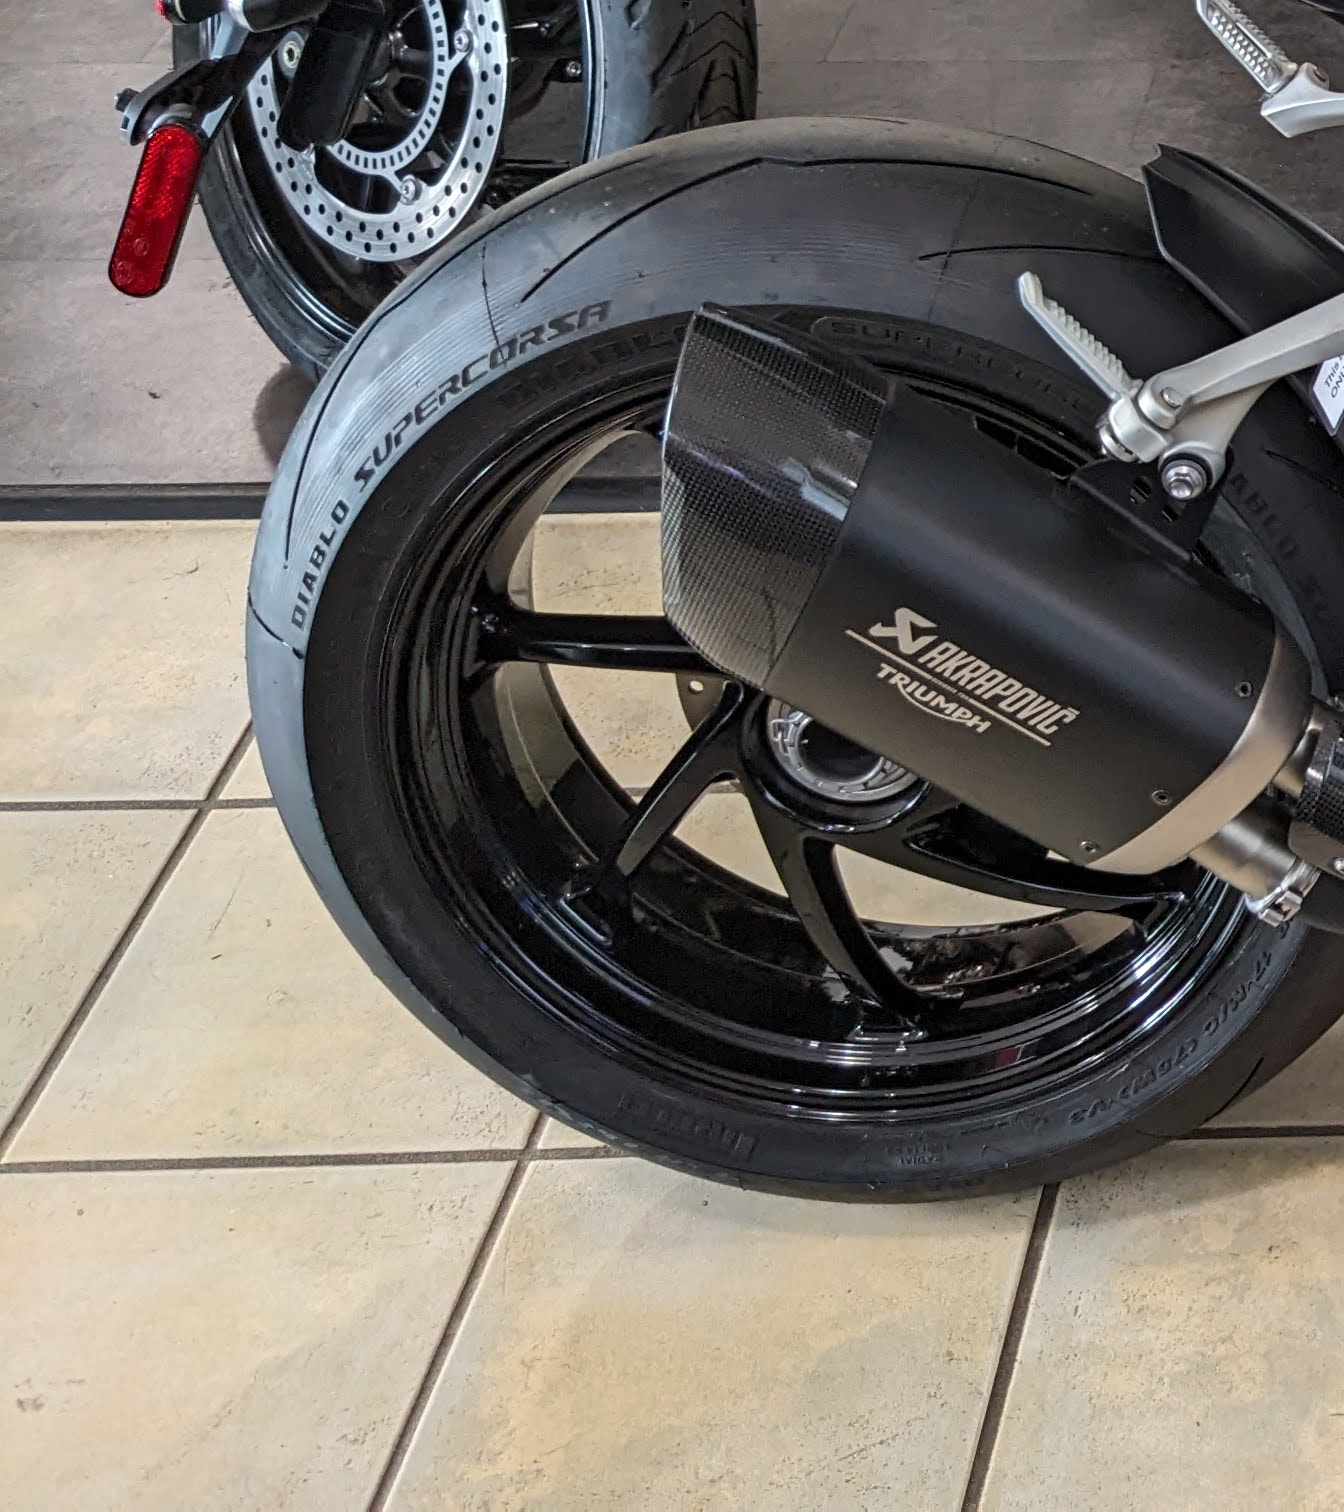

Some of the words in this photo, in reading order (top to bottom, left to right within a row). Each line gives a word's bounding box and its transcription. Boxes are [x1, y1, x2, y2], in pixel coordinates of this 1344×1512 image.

[1323, 361, 1340, 388] This
[291, 498, 350, 632] DIABLO
[353, 299, 613, 493] SUPERCORSA
[876, 663, 992, 735] TRIUMPH
